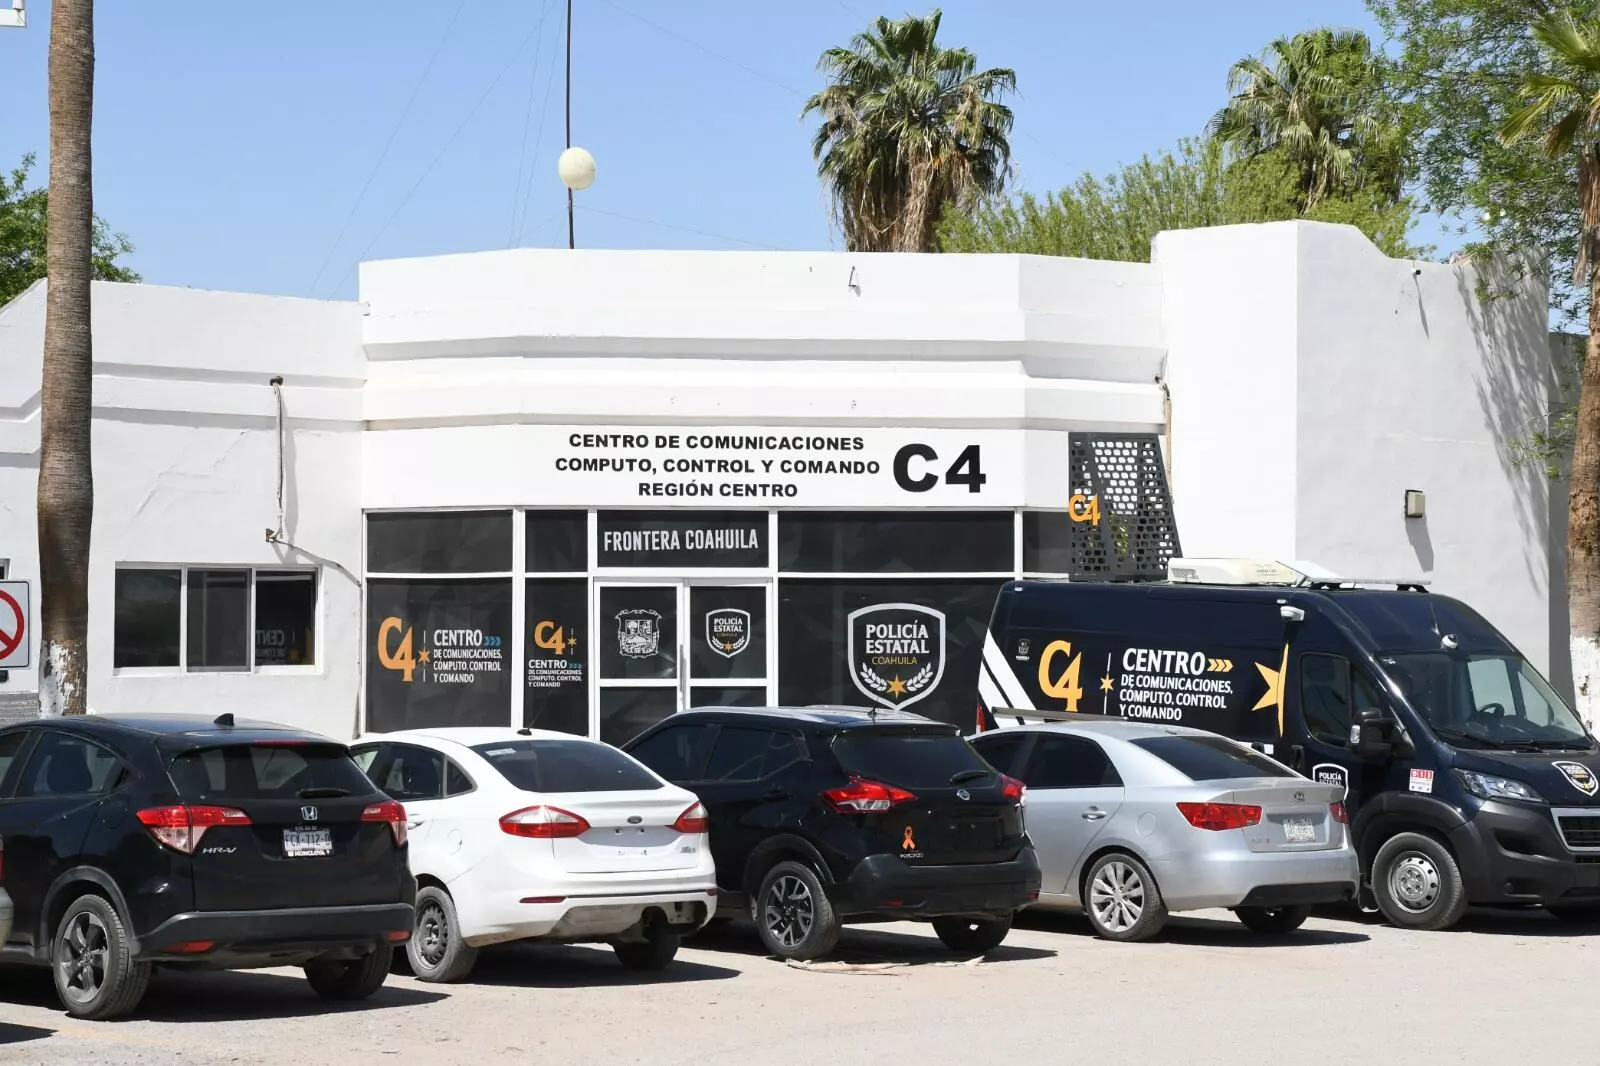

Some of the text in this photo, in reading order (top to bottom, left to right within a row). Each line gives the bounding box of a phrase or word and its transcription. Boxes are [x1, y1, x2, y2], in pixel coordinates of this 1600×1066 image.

[569, 433, 864, 450] CENTRO DE COMUNICACIONES
[555, 458, 880, 474] COMPUTO, CONTROL Y COMANDO
[893, 443, 986, 493] C4
[638, 480, 798, 497] REGIÓN CENTRO
[1068, 493, 1101, 526] C4
[604, 528, 759, 551] FRONTERA COAHUILA
[713, 616, 743, 625] POLICÍA
[433, 629, 482, 646] CENTRO
[534, 620, 566, 655] C4
[865, 620, 929, 639] POLICÍA
[377, 616, 416, 682] C4
[433, 649, 503, 659] DE COMUNICACIONES,
[865, 640, 930, 654] ESTATAL
[469, 661, 501, 671] CONTROL
[528, 659, 567, 669] CENTRO
[871, 656, 918, 665] COAHUILA
[1122, 648, 1206, 675] CENTRO
[433, 673, 474, 683] Y COMANDO
[1038, 640, 1083, 713] C4
[1121, 674, 1233, 694] DE COMUNICACIONES,
[1176, 693, 1227, 708] CONTROL
[1119, 704, 1182, 720] Y COMANDO
[1318, 771, 1342, 781] POLICÍA
